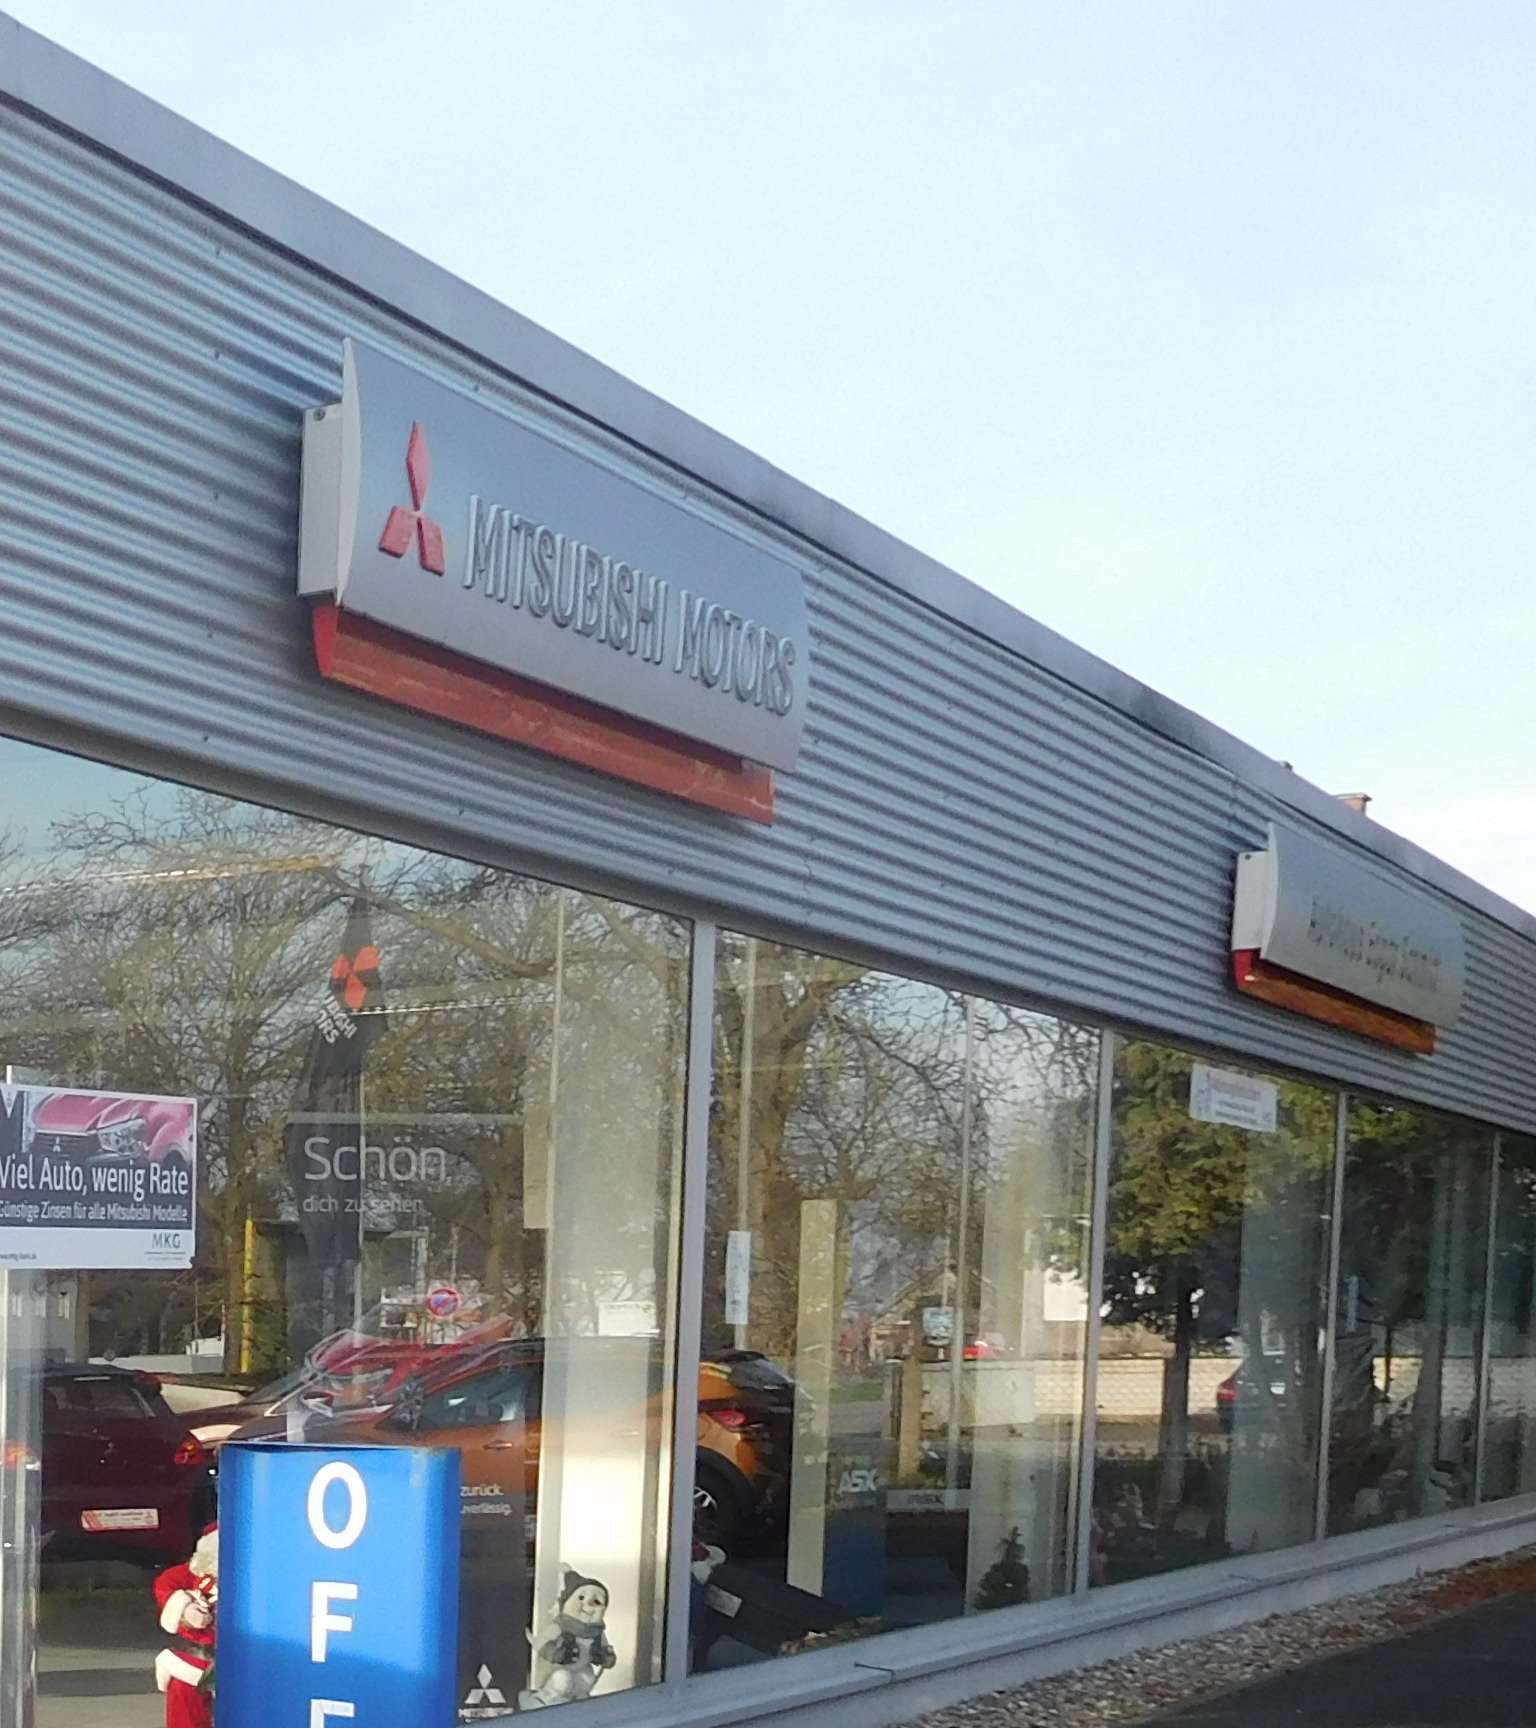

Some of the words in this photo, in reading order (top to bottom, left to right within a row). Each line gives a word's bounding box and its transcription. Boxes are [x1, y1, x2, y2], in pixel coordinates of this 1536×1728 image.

[462, 494, 669, 665] MITSUBISHI
[673, 589, 796, 716] MOTORS
[303, 1136, 446, 1181] Schön
[39, 1157, 88, 1196] Auto,
[91, 1160, 145, 1202] wenig
[150, 1162, 189, 1195] Rate
[40, 1200, 73, 1220] Zinsen
[73, 1201, 88, 1220] für
[88, 1202, 106, 1220] alle
[107, 1202, 152, 1221] Mitsubishi
[152, 1205, 188, 1222] Modelle
[303, 1194, 339, 1213] dich
[152, 1233, 182, 1249] MKG
